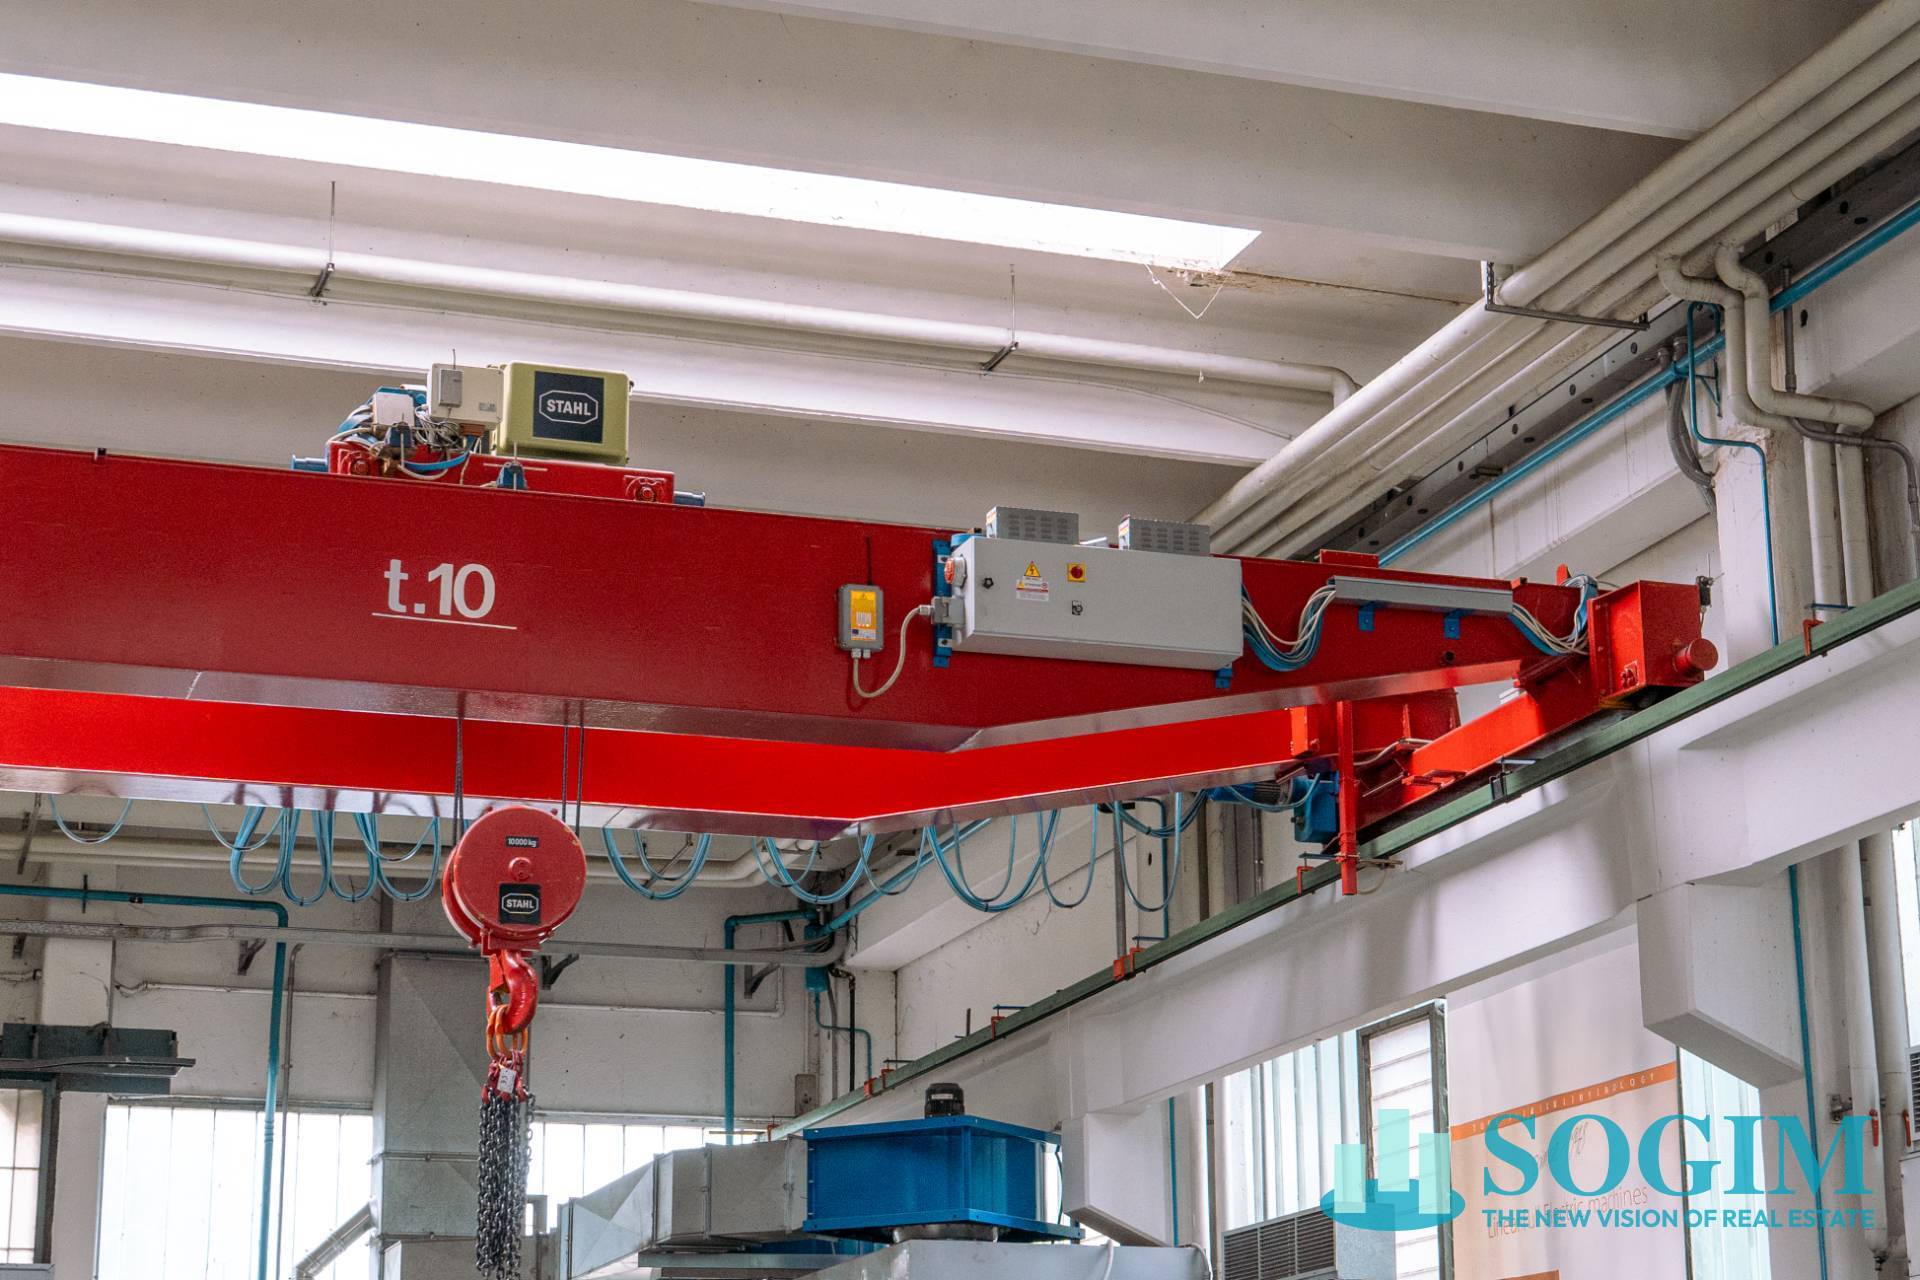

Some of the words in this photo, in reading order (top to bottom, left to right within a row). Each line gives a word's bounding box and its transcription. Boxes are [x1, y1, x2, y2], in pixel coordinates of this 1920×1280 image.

[546, 399, 591, 416] STAHL
[384, 559, 496, 618] t.10
[528, 839, 537, 848] kg
[506, 899, 534, 909] STAHL
